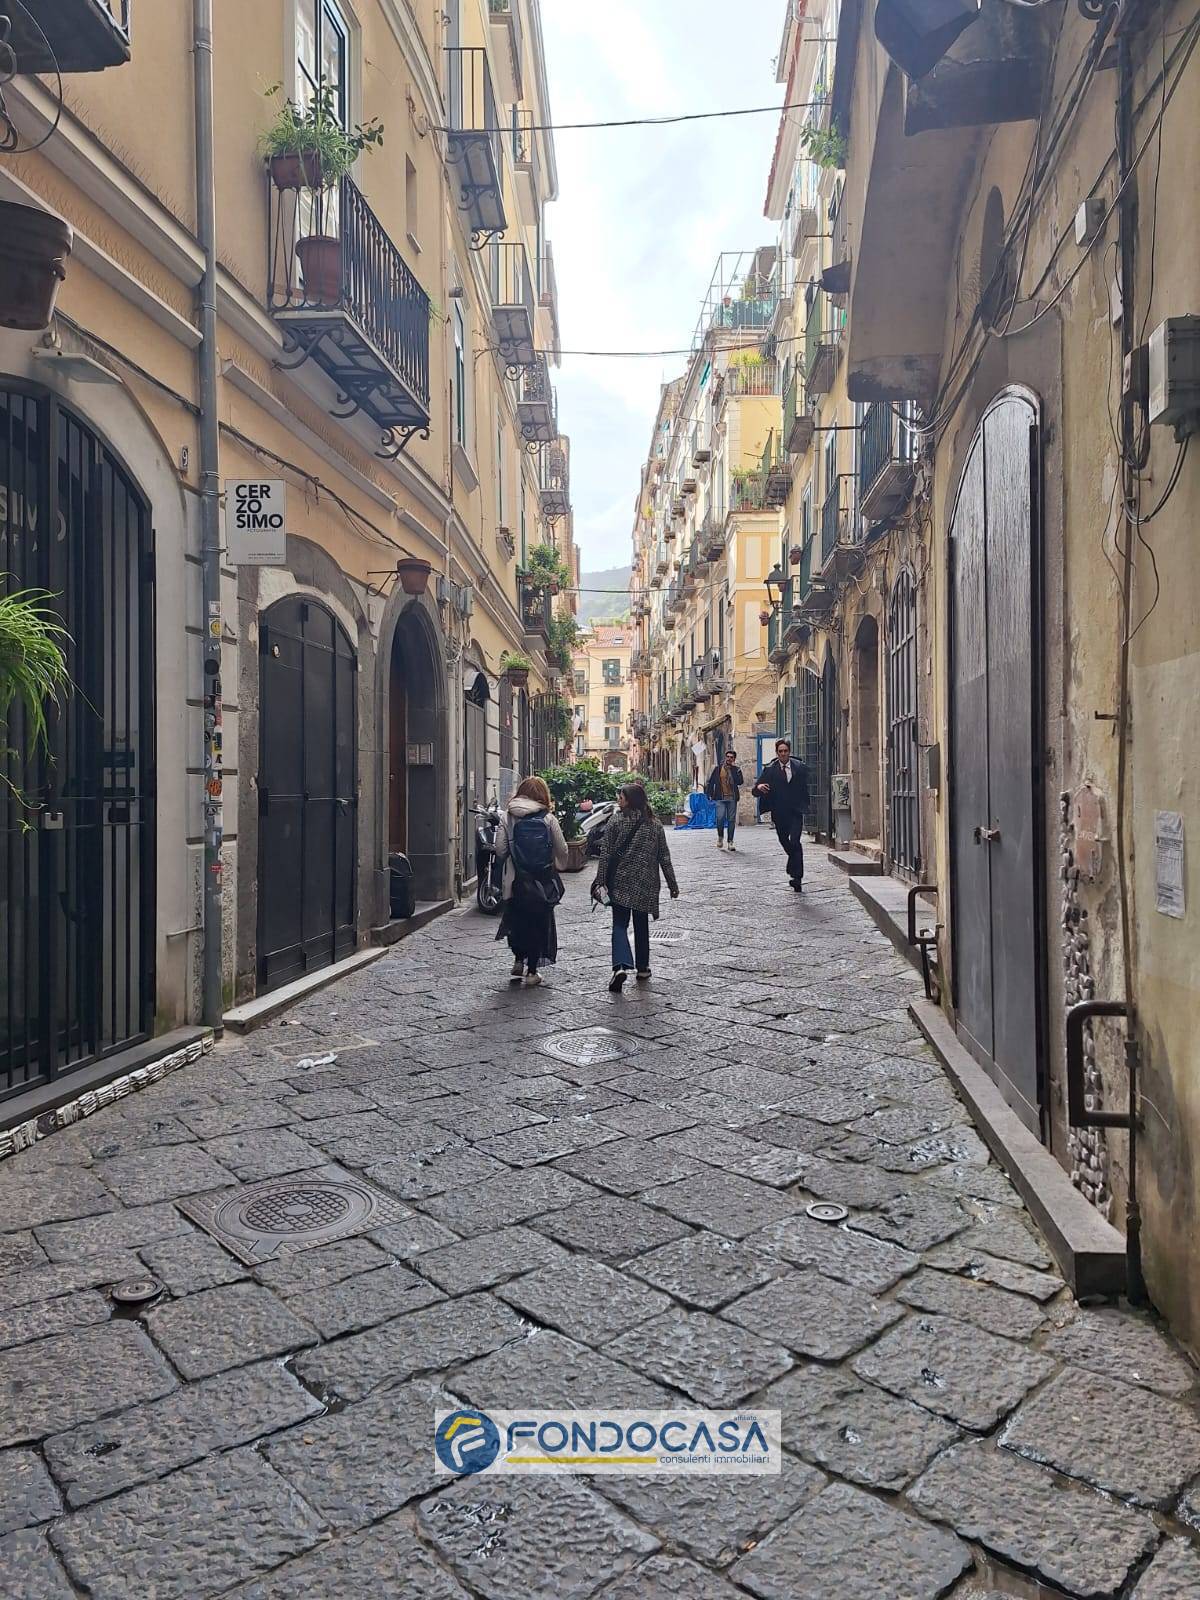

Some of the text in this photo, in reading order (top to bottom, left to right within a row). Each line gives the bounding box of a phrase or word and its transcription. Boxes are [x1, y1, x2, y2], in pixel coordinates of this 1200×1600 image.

[182, 449, 188, 466] 9
[235, 484, 271, 499] CER
[235, 499, 262, 514] ZO
[236, 513, 284, 529] SIMO
